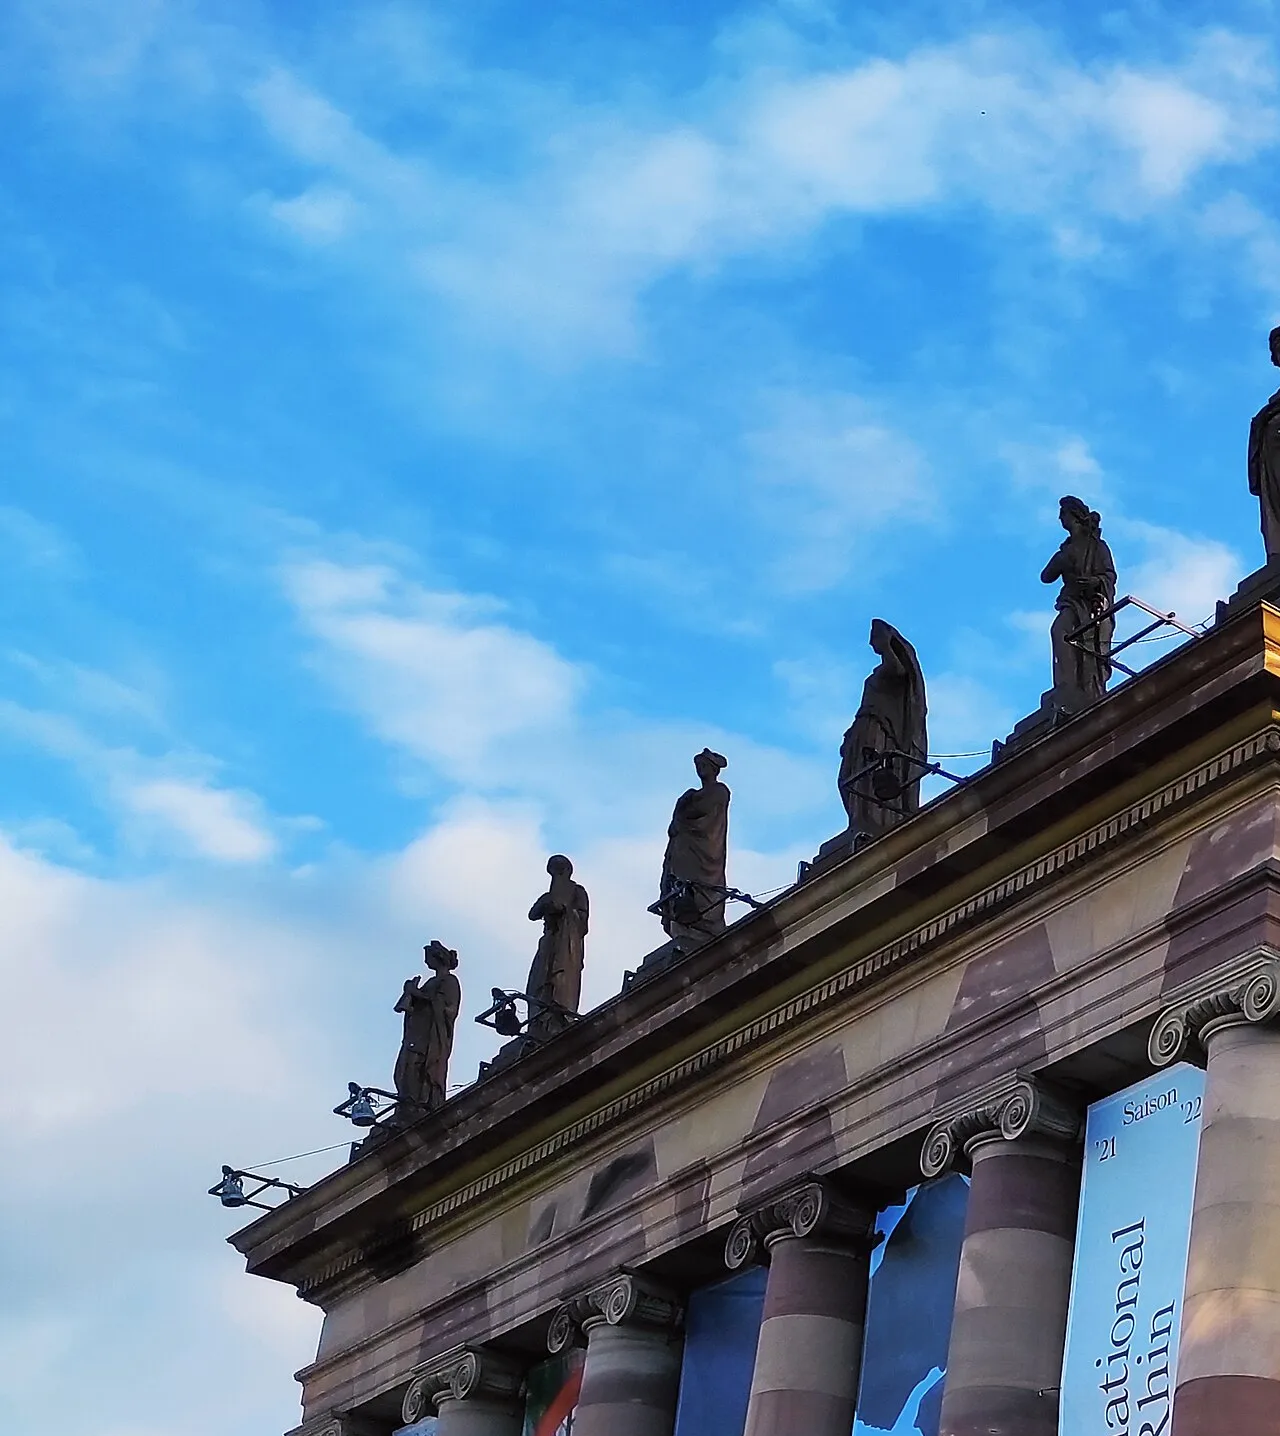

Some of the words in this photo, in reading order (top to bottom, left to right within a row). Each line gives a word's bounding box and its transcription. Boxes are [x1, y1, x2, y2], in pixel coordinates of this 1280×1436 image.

[1095, 1136, 1116, 1162] '21
[1181, 1096, 1202, 1124] '22
[1123, 1088, 1177, 1126] Saison
